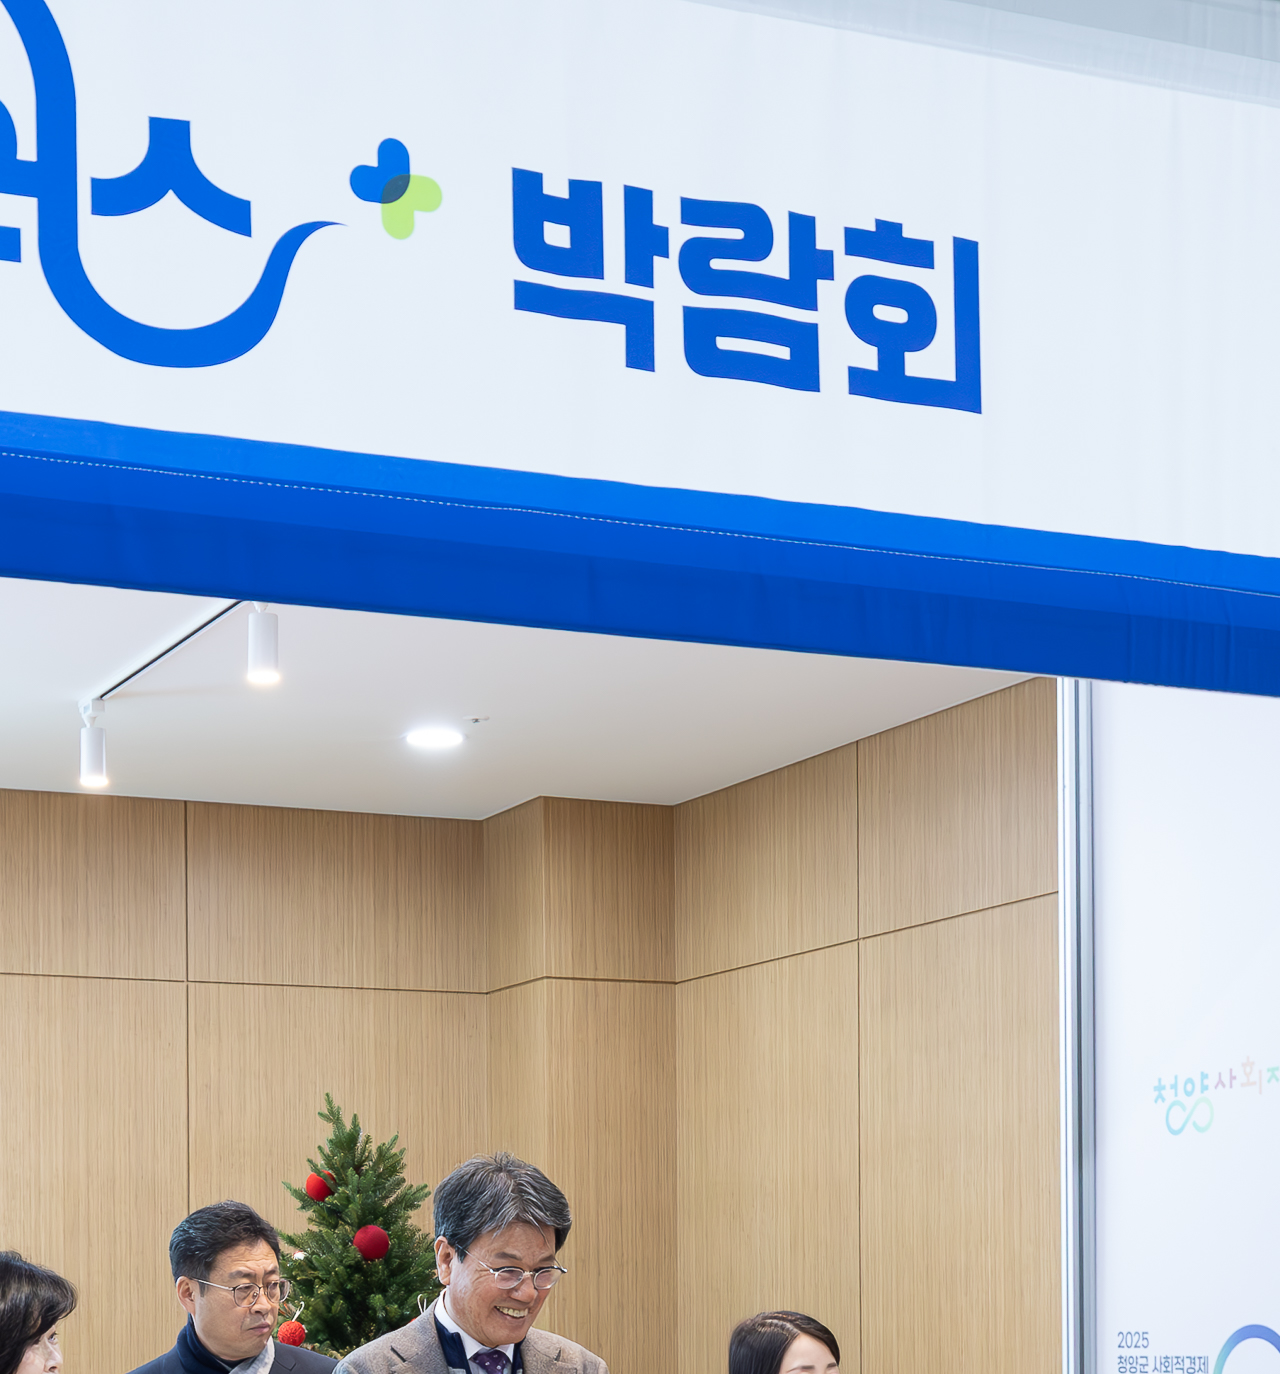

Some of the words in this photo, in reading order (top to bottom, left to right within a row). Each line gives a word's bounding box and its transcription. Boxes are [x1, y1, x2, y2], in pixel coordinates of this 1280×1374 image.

[512, 167, 982, 414] 박람회
[1117, 1330, 1150, 1349] 2025
[1117, 1355, 1149, 1374] 청양군
[1152, 1355, 1209, 1374] 사회적경제
